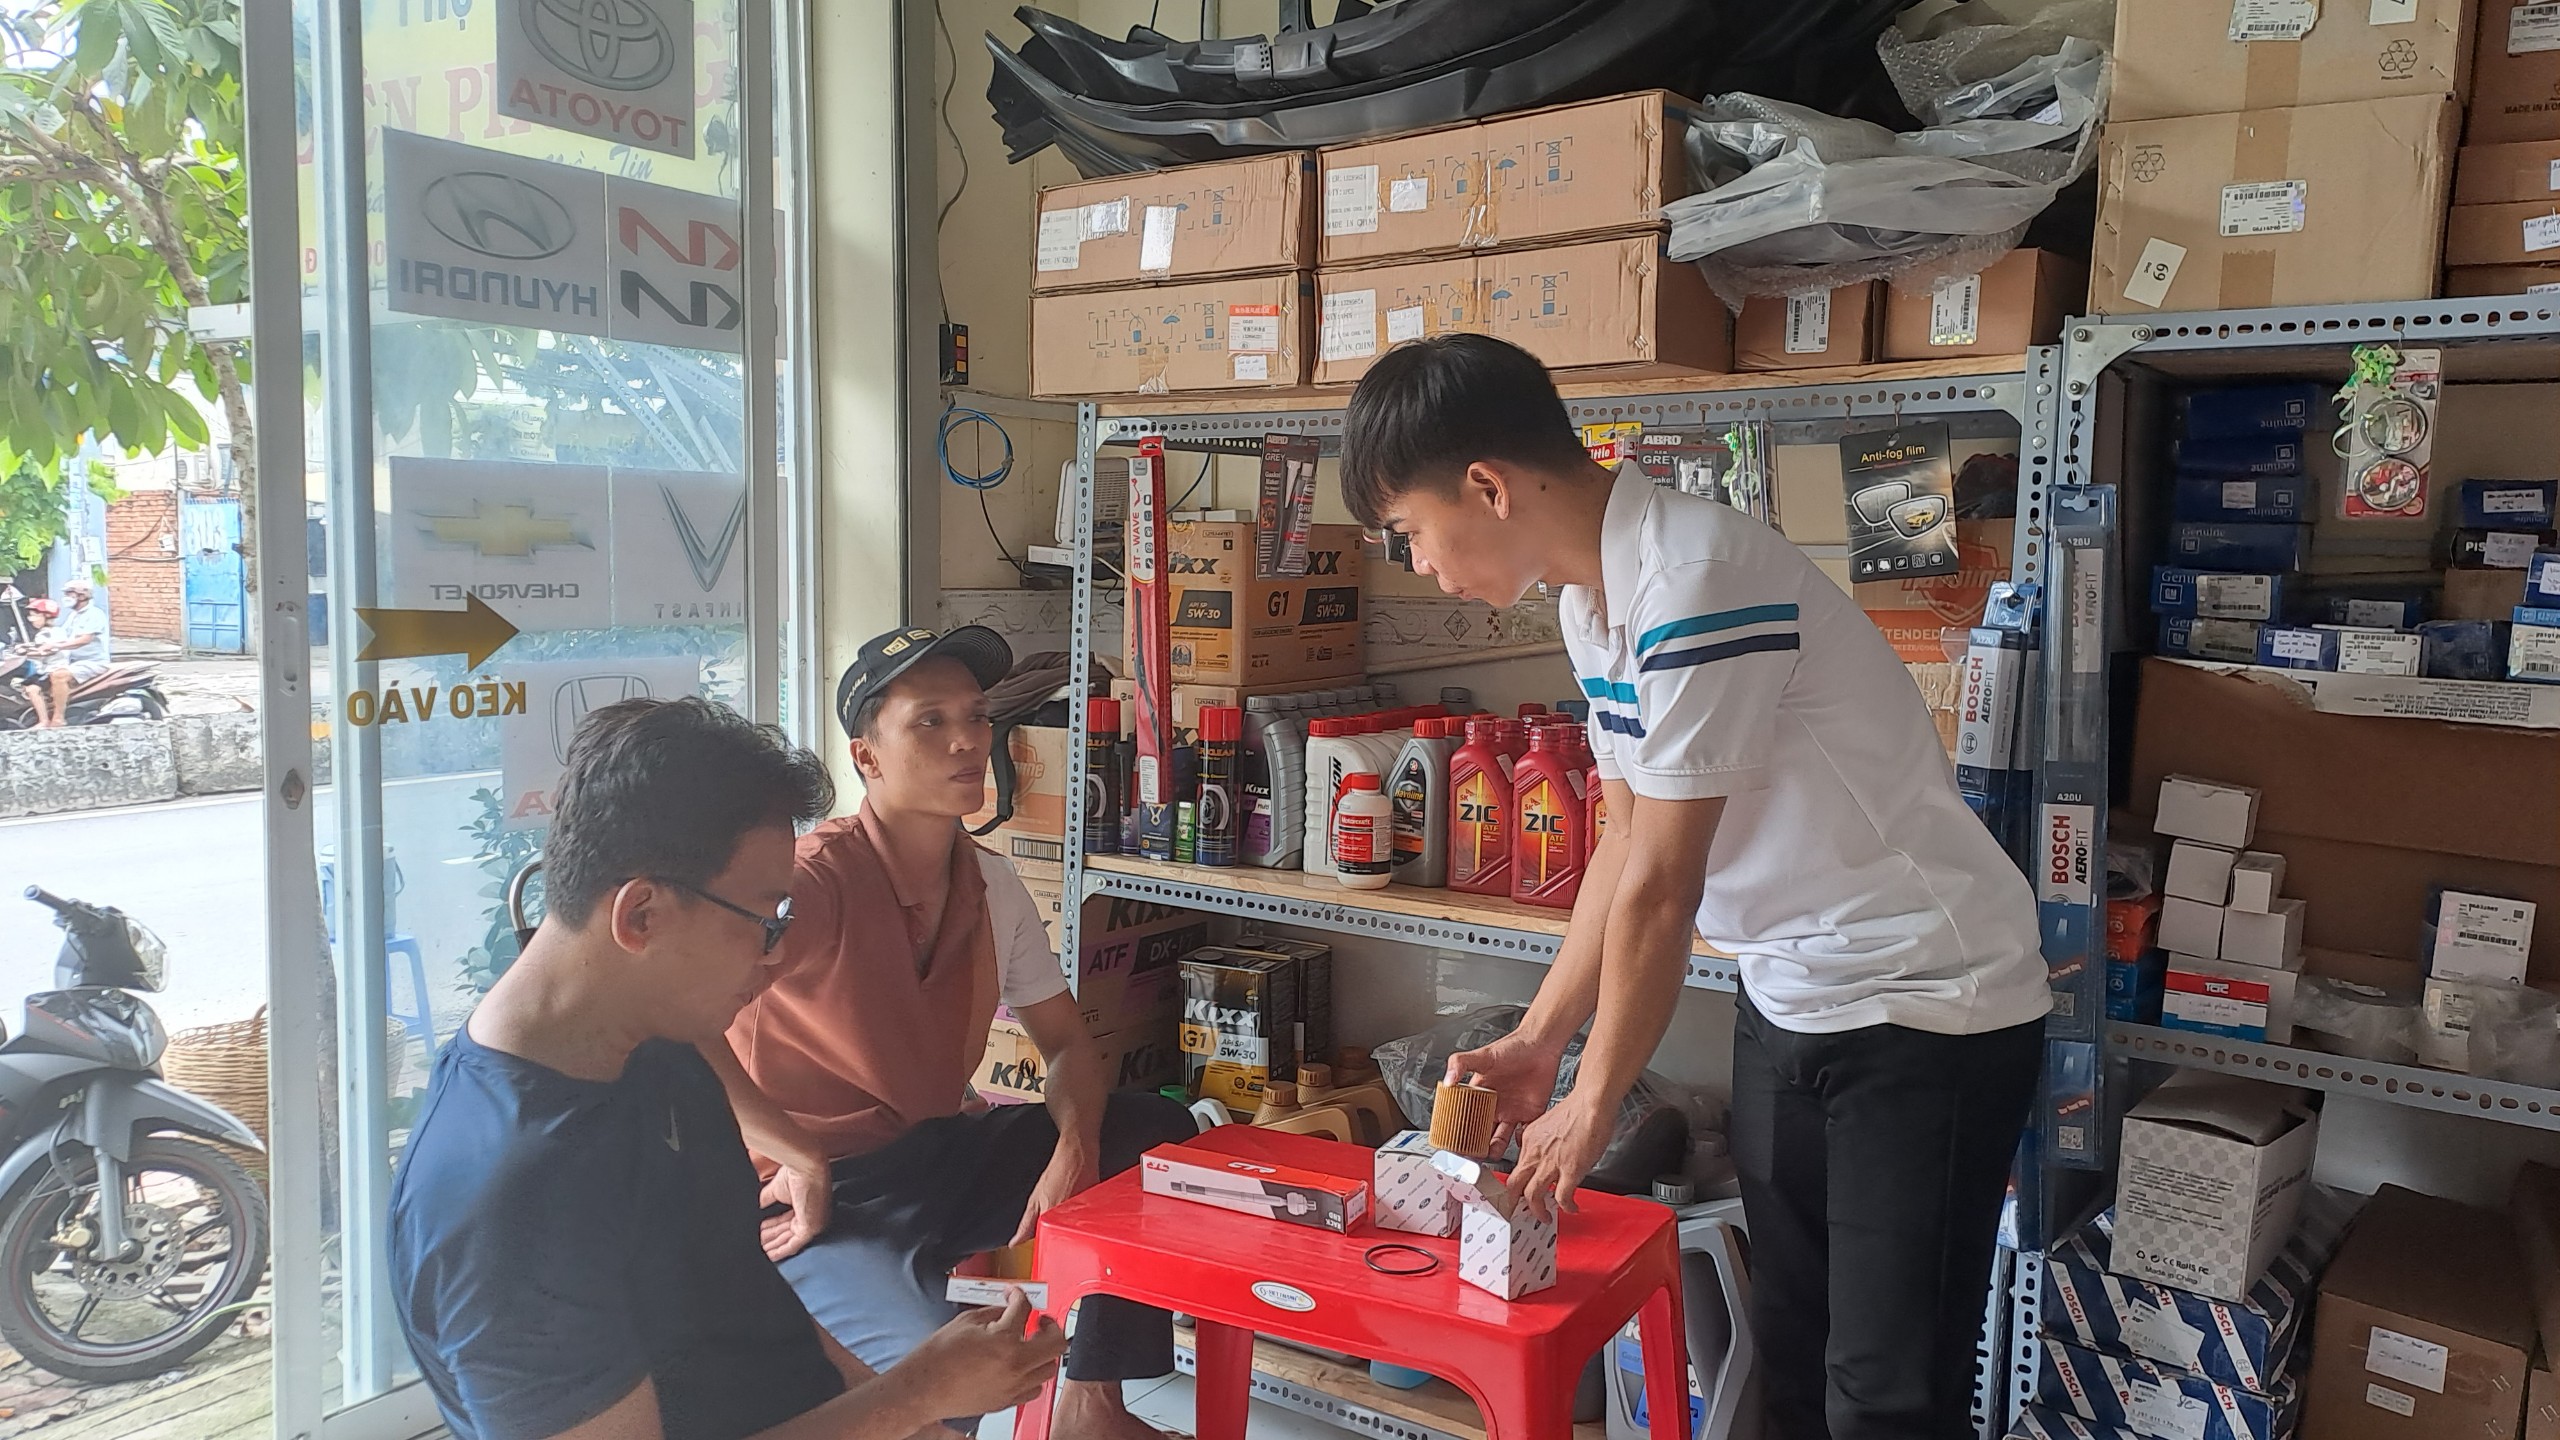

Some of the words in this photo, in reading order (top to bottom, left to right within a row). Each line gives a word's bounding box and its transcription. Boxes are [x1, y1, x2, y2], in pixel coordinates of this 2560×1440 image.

[1642, 434, 1682, 446] ABRO
[1264, 452, 1286, 461] GREY
[1642, 455, 1681, 465] GREY
[1860, 449, 1903, 464] Anti-fog
[1905, 444, 1926, 457] film
[1297, 503, 1312, 513] GRE
[1132, 512, 1141, 546] WAVE
[1133, 555, 1141, 569] 3T
[1168, 552, 1220, 575] ixx
[1186, 608, 1222, 619] 5W-30
[1267, 590, 1290, 617] G1
[1315, 603, 1346, 618] 5W-30
[1965, 656, 1984, 723] BOSCH
[1980, 669, 1996, 724] AEROFIT
[1244, 783, 1270, 796] Kixx
[1459, 794, 1469, 802] SK
[2056, 792, 2083, 802] A20U
[1458, 803, 1500, 823] ZIC
[1524, 813, 1566, 833] ZIC
[1483, 824, 1500, 832] ATF
[2050, 814, 2072, 886] BOSCH
[2074, 827, 2091, 885] AEROFIT
[1087, 942, 1131, 976] ATF
[1184, 998, 1260, 1028] Kixx
[1183, 1029, 1208, 1049] G1
[1219, 1047, 1258, 1061] 5W-30
[1227, 1161, 1277, 1174] CTR
[1325, 1218, 1342, 1230] RACK
[1328, 1211, 1342, 1222] END
[2145, 1265, 2167, 1278] Made
[2175, 1273, 2198, 1285] China
[2062, 1286, 2085, 1324] BOSCH
[2058, 1361, 2082, 1399] BOSCH
